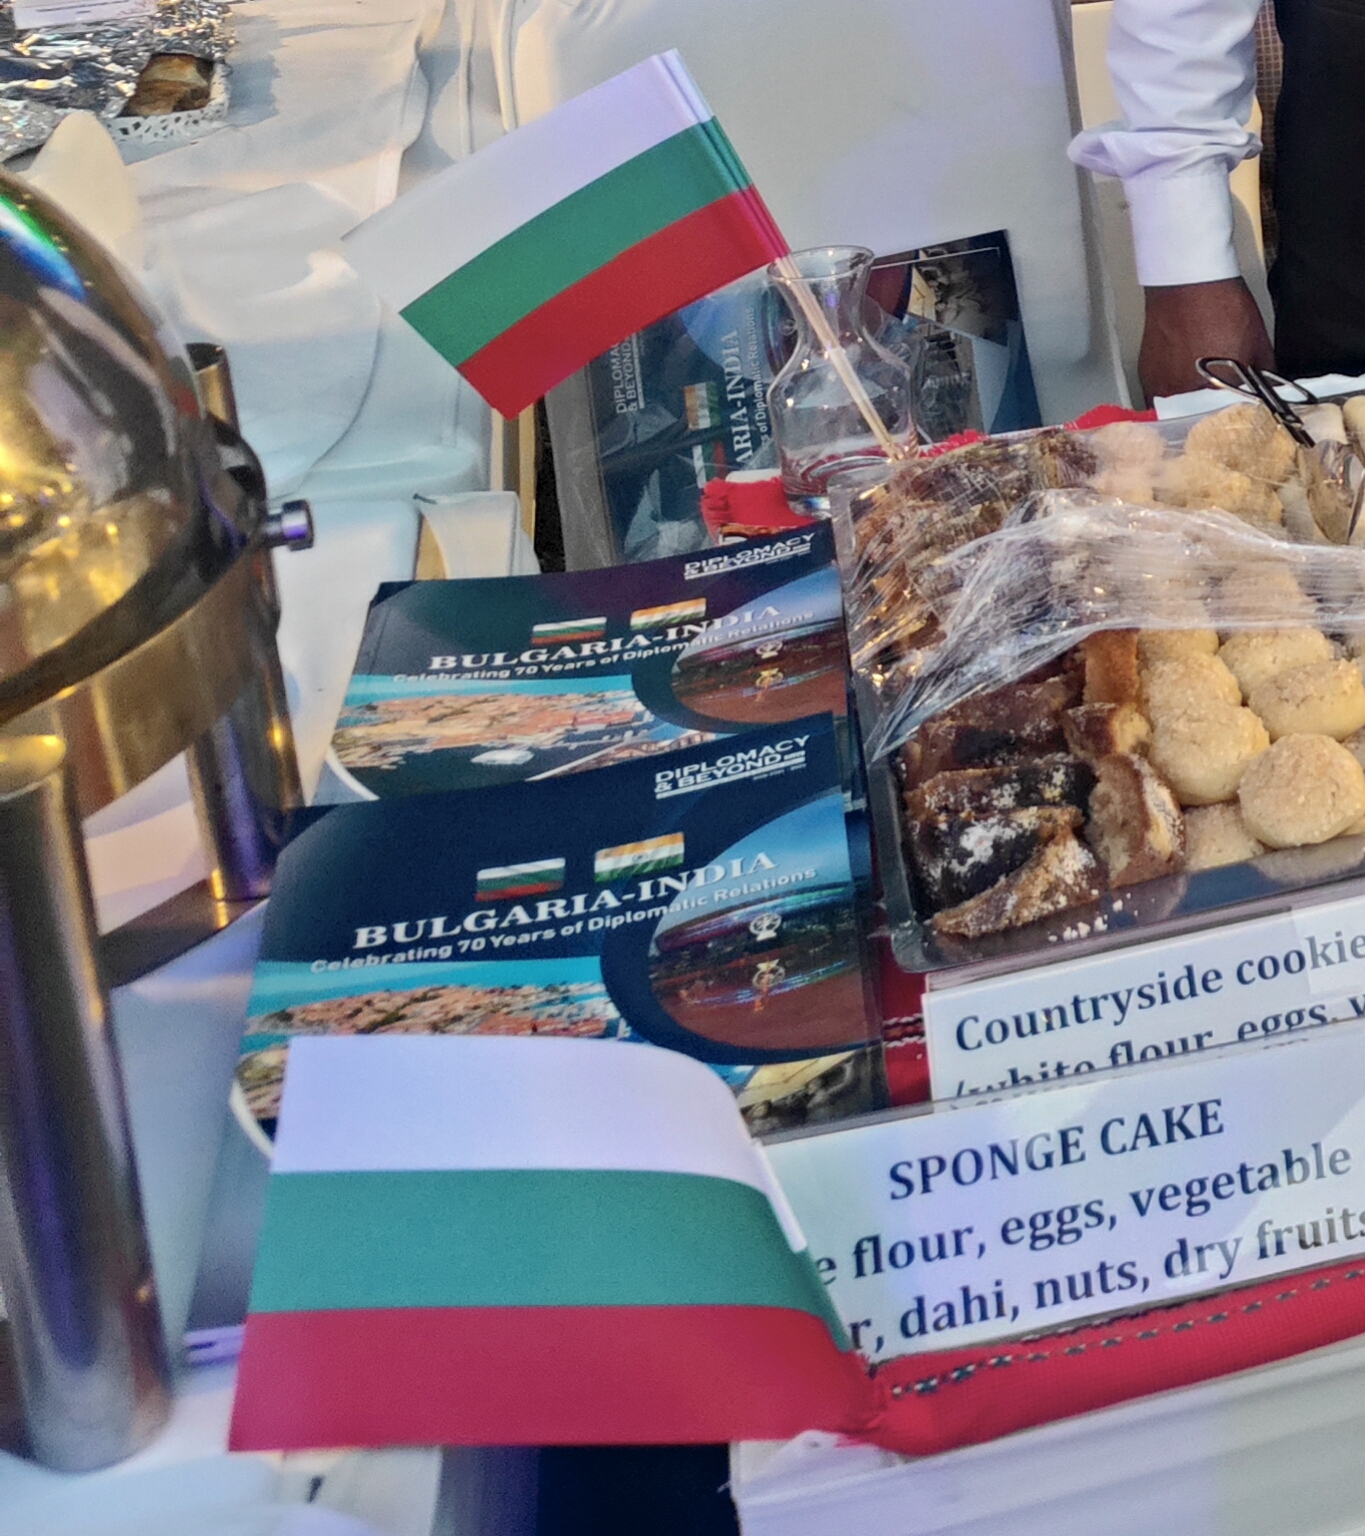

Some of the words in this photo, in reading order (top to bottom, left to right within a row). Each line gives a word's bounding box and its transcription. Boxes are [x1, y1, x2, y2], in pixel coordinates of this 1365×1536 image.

[610, 341, 627, 414] DIPLOMA
[622, 341, 637, 401] BEYOND
[721, 329, 753, 464] ARIA-INDIA
[752, 363, 767, 419] Diplomatic
[684, 533, 815, 571] DIPLOMACY
[393, 667, 510, 684] Celebrating
[513, 663, 539, 677] 70
[542, 657, 596, 676] Years
[600, 653, 619, 666] of
[622, 632, 724, 665] Diplomatic
[728, 611, 815, 638] Relations
[427, 605, 783, 671] BULGARIA-INDIA
[654, 782, 673, 793] &
[677, 753, 782, 788] BEYOND
[655, 735, 810, 783] DIPLOMACY
[310, 940, 453, 974] Celebrating
[457, 935, 485, 954] 70
[487, 926, 555, 950] Years
[560, 920, 585, 940] of
[587, 892, 708, 934] Diplomatic
[713, 866, 817, 904] Relations
[352, 851, 778, 949] BULGARIA-INDIA
[955, 964, 1224, 1053] Countryside
[888, 1125, 1086, 1202] SPONGE
[1099, 1098, 1225, 1156] CAKE
[852, 1224, 987, 1280] flour,
[999, 1198, 1118, 1251] eggs,
[1129, 1142, 1352, 1231] vegetable
[899, 1278, 1021, 1341] dahi,
[1032, 1258, 1151, 1310] nuts,
[1163, 1234, 1245, 1282] dry
